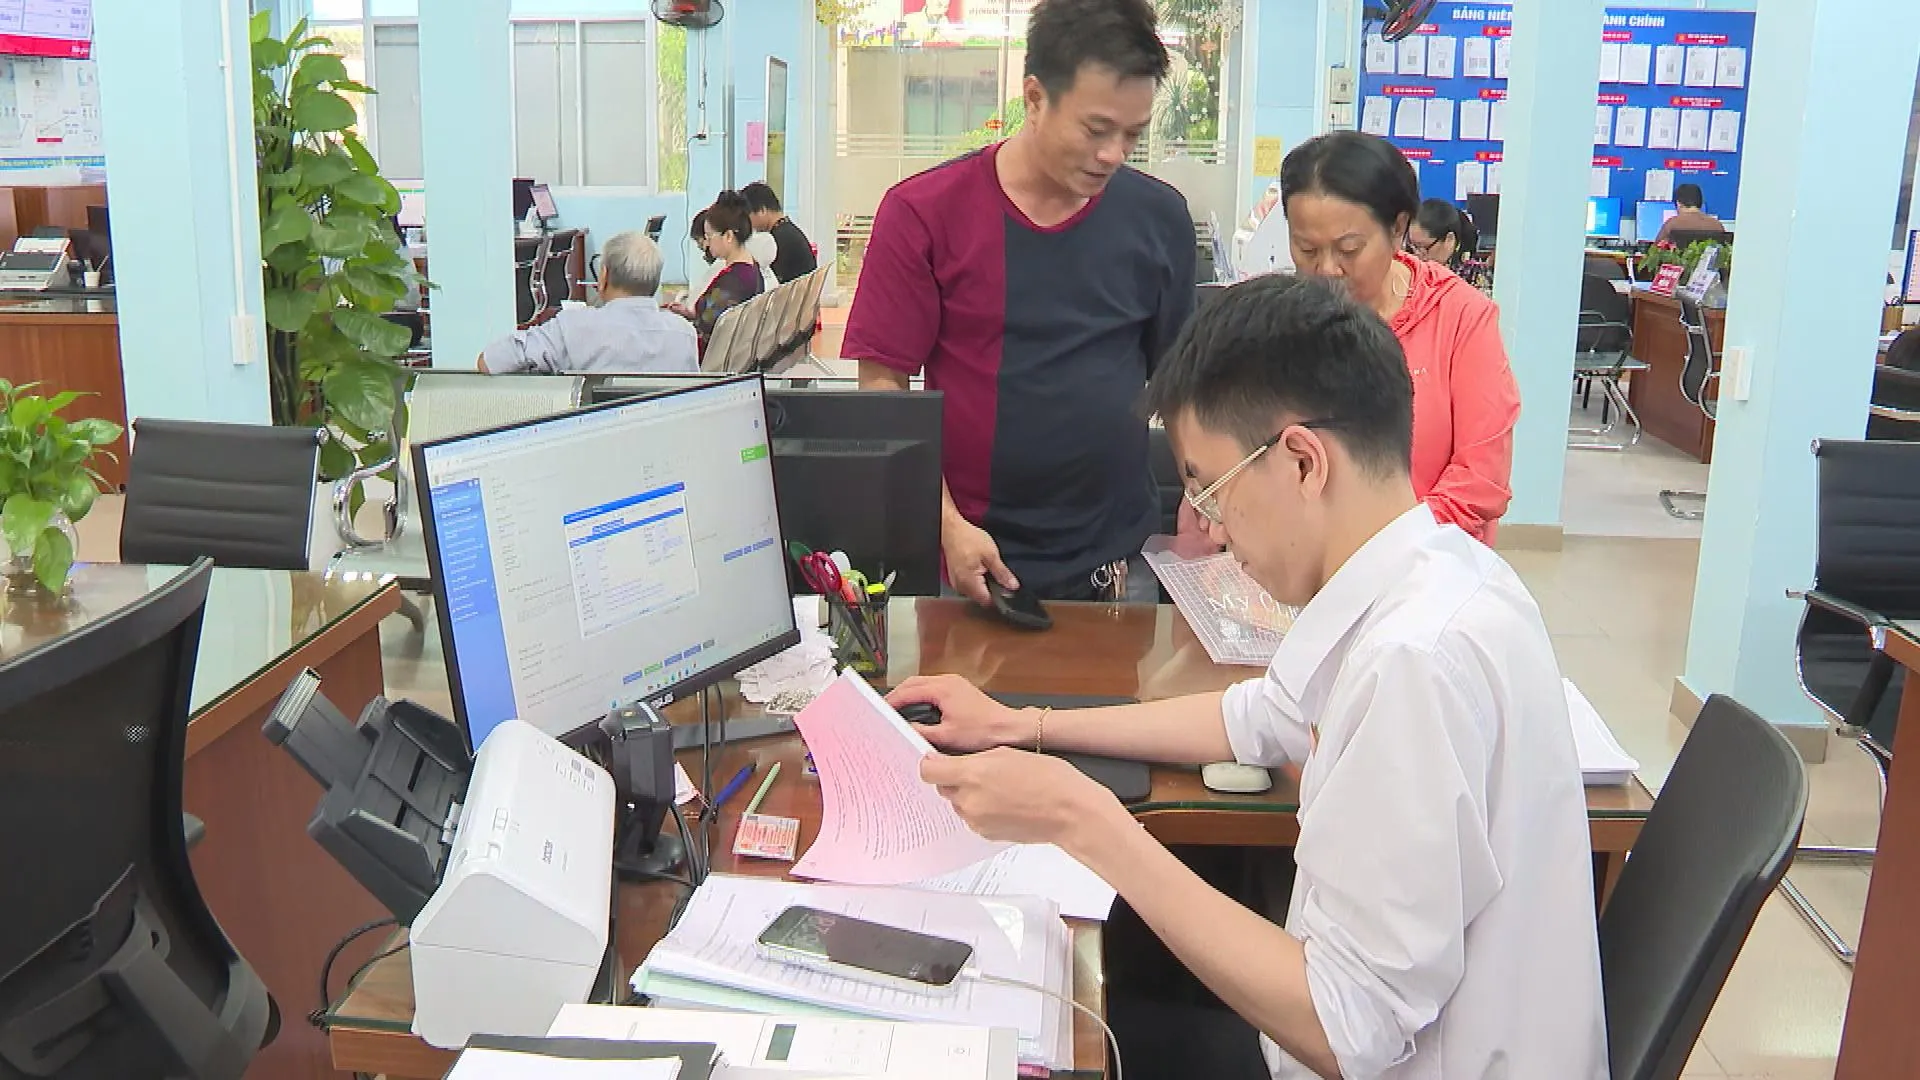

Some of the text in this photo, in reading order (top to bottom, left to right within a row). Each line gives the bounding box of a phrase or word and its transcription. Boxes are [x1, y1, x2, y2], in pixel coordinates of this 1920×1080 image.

[1452, 6, 1485, 21] BẢNG
[1602, 12, 1626, 27] ÀNH
[1629, 13, 1665, 27] CHÍNH
